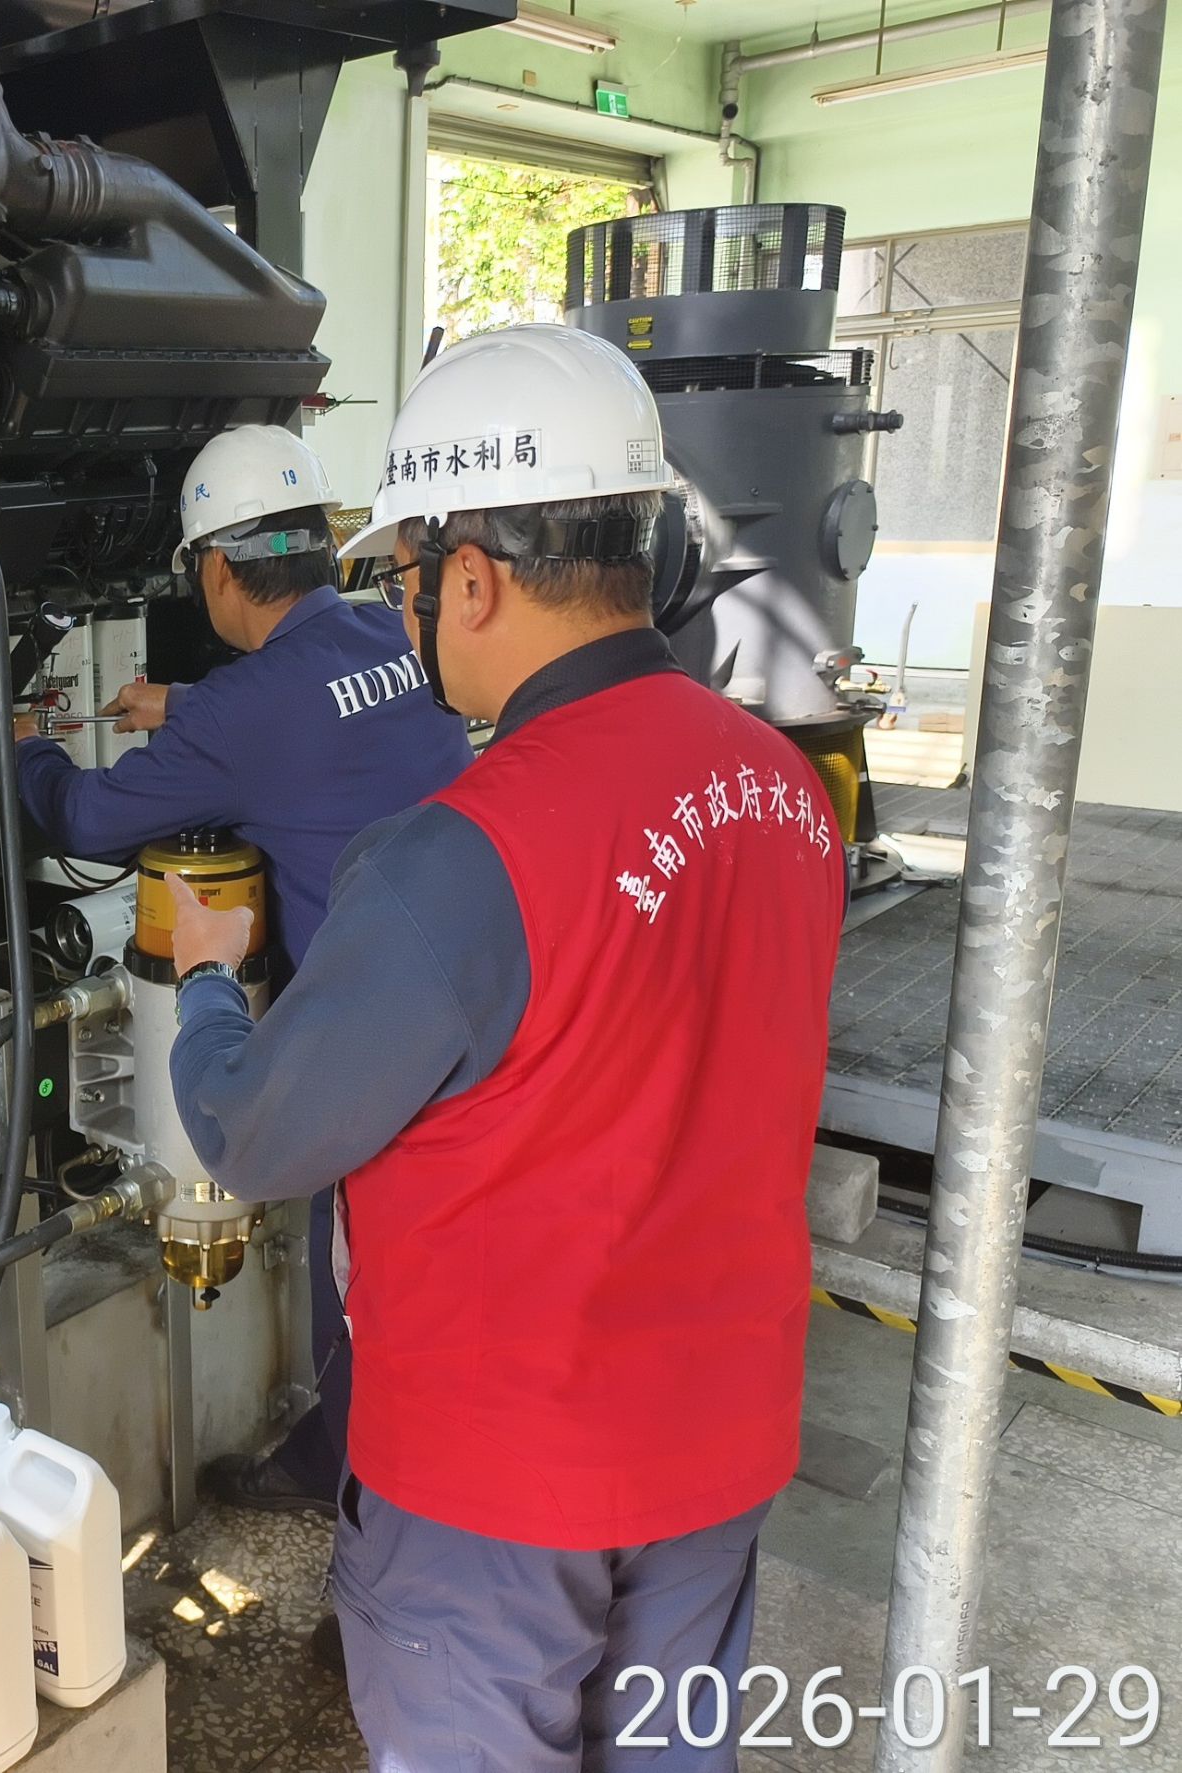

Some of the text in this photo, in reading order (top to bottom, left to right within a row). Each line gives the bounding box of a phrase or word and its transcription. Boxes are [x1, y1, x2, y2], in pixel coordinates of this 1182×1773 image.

[386, 434, 537, 486] 臺南市水利局
[282, 469, 297, 486] 19
[37, 1659, 56, 1673] GAL
